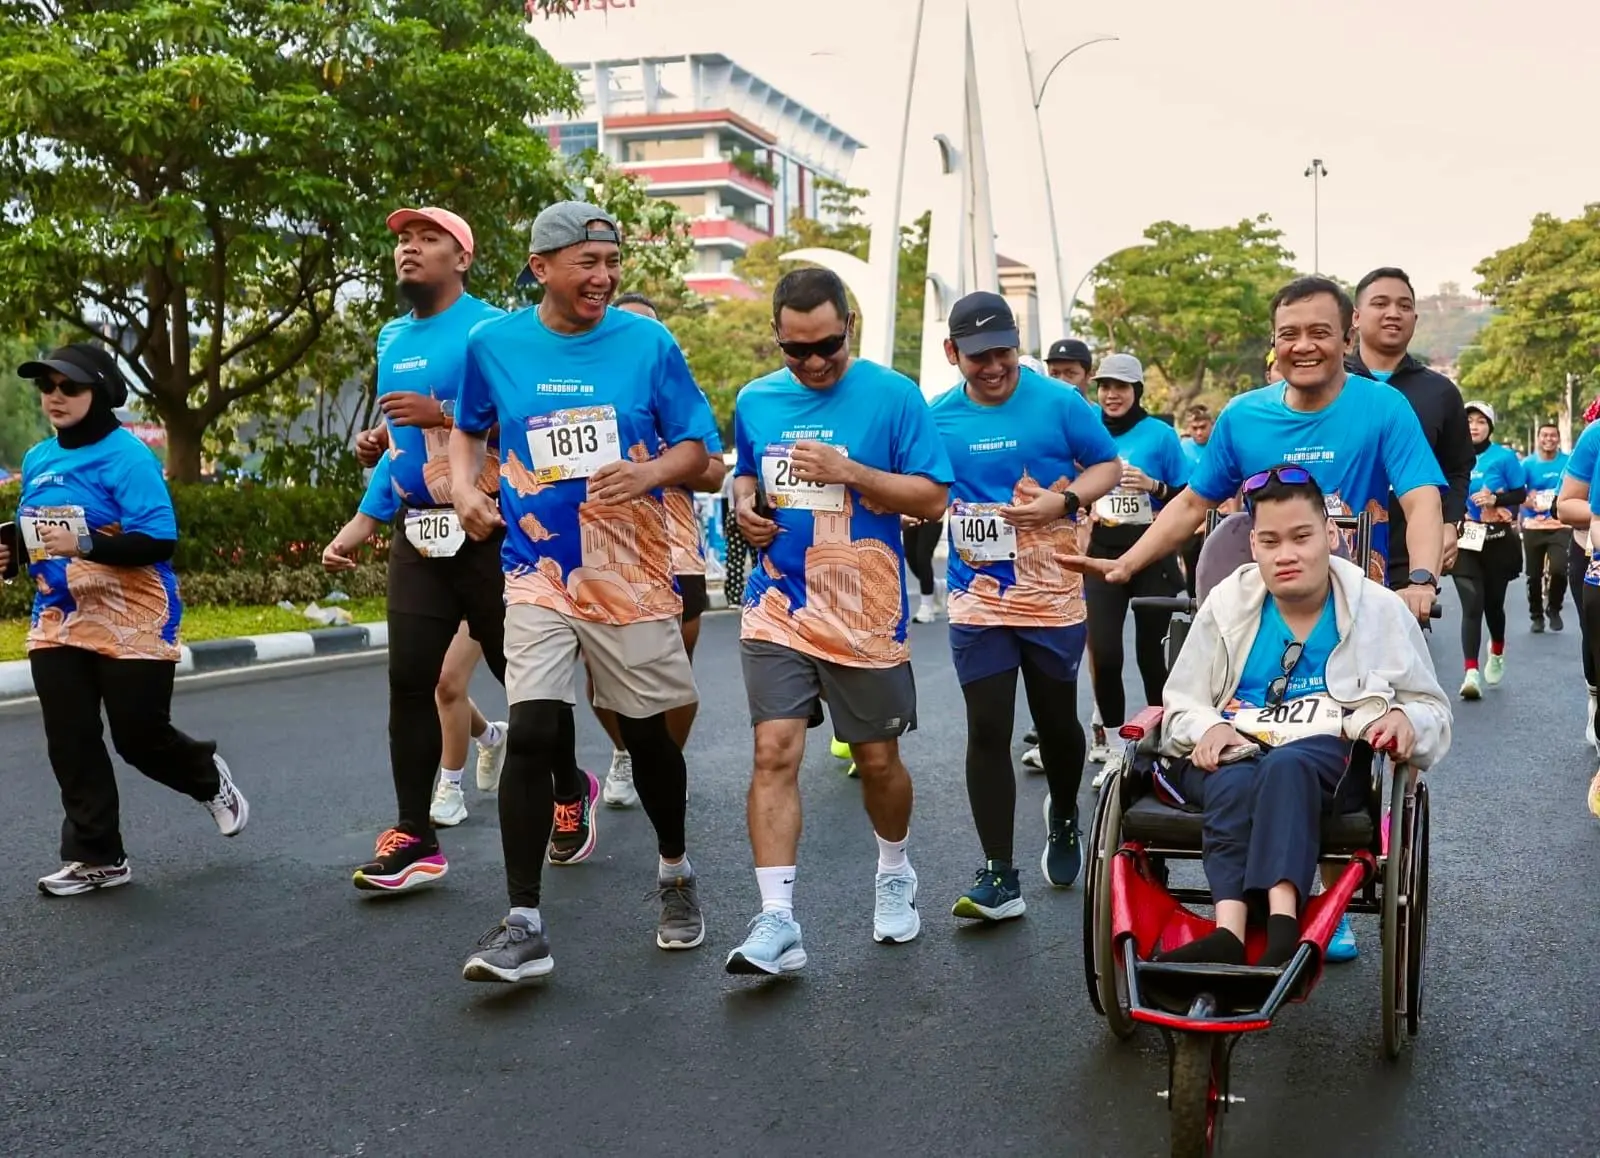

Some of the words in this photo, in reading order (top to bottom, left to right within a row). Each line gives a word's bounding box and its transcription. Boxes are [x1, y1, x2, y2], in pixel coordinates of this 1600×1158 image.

[536, 384, 579, 392] FRIENDSHIP
[580, 384, 594, 392] RUN
[546, 424, 598, 457] 1813
[781, 430, 819, 439] FRIENDSHIP
[820, 429, 834, 438] RUN
[1110, 496, 1140, 514] 1755
[418, 516, 449, 541] 1216
[960, 518, 999, 542] 1404
[1256, 698, 1320, 724] 2027
